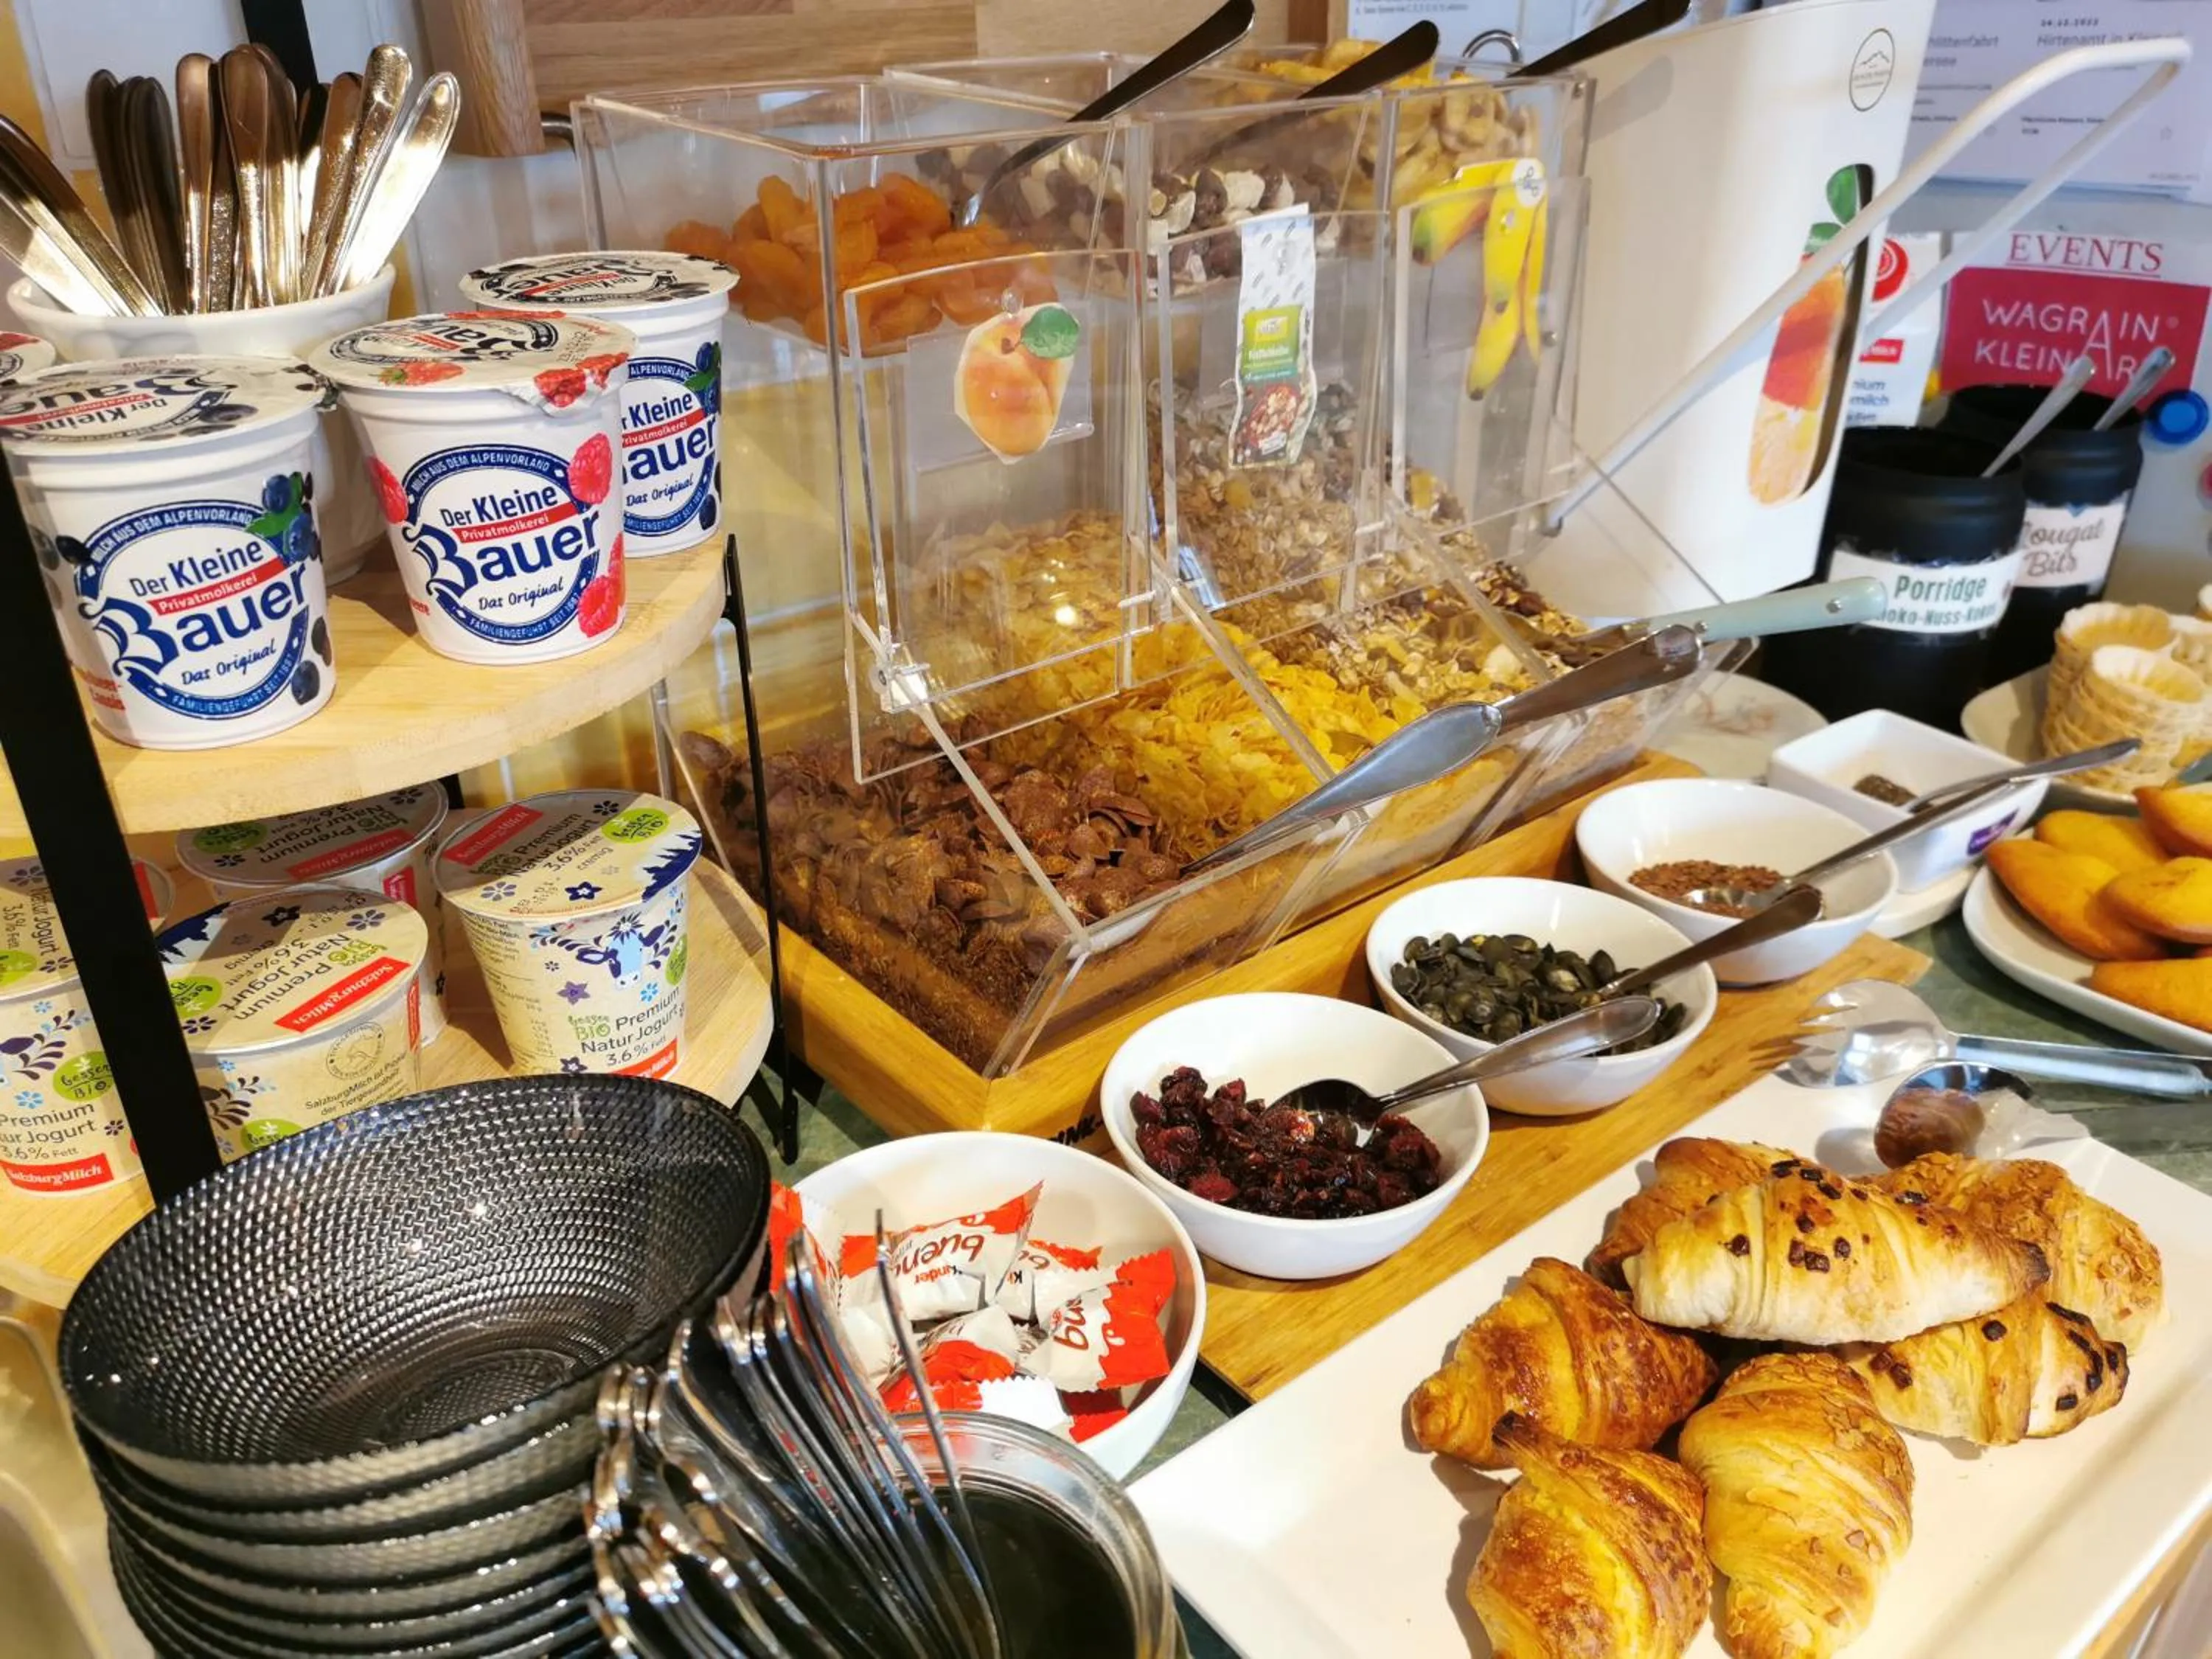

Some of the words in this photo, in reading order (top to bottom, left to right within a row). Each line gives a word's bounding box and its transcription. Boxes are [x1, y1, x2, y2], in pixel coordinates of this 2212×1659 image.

[2008, 233, 2164, 273] EVENTS
[1981, 298, 2160, 352] WAGRAIN
[1974, 321, 2137, 380] KLEINAR
[26, 406, 128, 433] Kleine
[628, 392, 693, 428] Kleine
[622, 417, 716, 484] auer
[623, 421, 689, 445] rivatmolkerei
[470, 452, 551, 472] ALPENVORLAND
[439, 508, 473, 526] Der
[472, 486, 558, 524] Kleine
[626, 493, 648, 507] Das
[651, 473, 694, 502] Original
[163, 507, 254, 526] ALPENVORLAND
[461, 515, 550, 540] Privatmolkerei
[129, 575, 169, 597] Der
[168, 540, 265, 589] Kleine
[402, 510, 599, 599] Bauer
[159, 572, 259, 613] Privatmolkerei
[479, 596, 504, 611] Das
[508, 576, 564, 607] Original
[1893, 575, 1986, 602] Porridge
[78, 563, 306, 676] Bauer
[181, 669, 211, 685] Das
[215, 637, 277, 675] Original
[512, 813, 582, 855] Premium
[31, 917, 60, 956] Jogurt
[292, 933, 351, 970] Natur
[218, 966, 292, 1012] Jogurt
[234, 961, 333, 1020] Premium
[293, 964, 394, 1026] SalzburgMilch
[580, 1033, 632, 1054] Natur
[635, 1004, 678, 1042] Jogurt
[615, 986, 680, 1033] Premium
[26, 1120, 97, 1144] Jogurt
[52, 1147, 80, 1158] Fett
